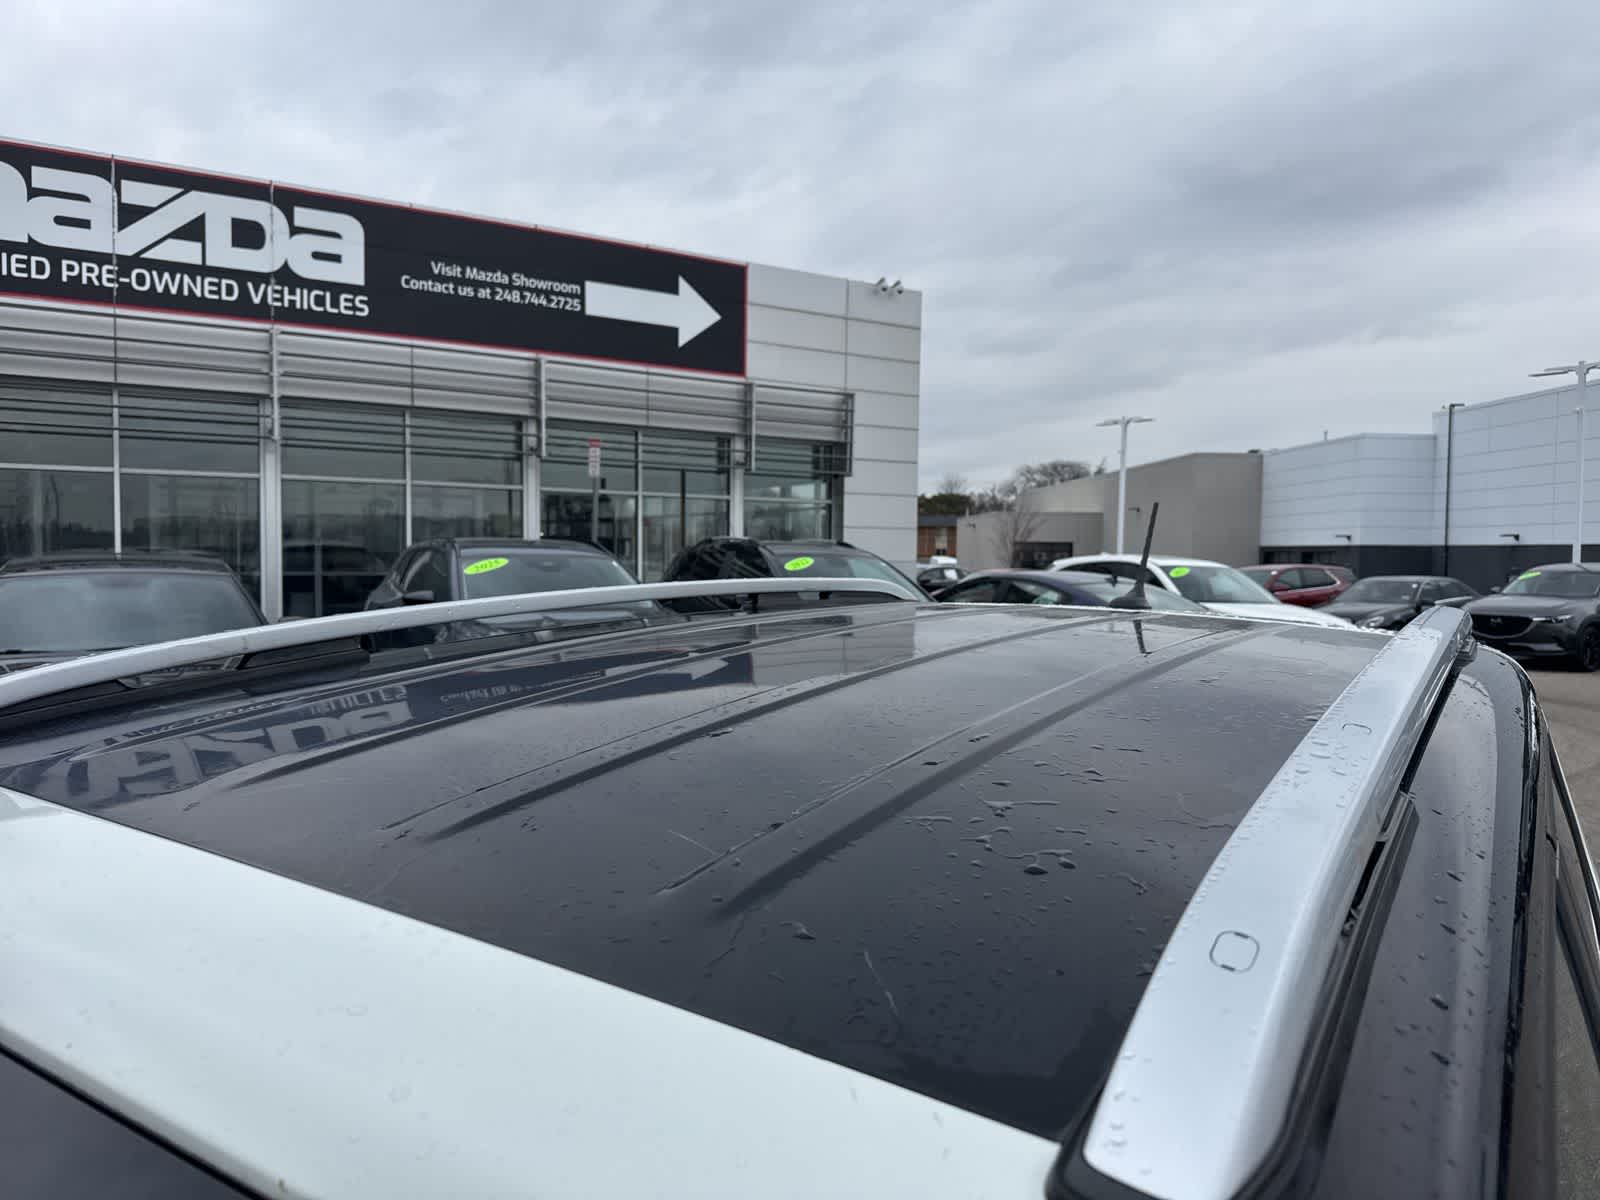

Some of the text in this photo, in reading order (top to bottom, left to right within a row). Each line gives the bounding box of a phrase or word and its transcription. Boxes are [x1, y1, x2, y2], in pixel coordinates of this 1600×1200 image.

[61, 259, 239, 301] PRE-OWNED
[247, 282, 369, 317] VEHICLES
[400, 275, 581, 312] Contact us at 248.744.2725
[431, 261, 581, 295] Visit Mazda Showroom
